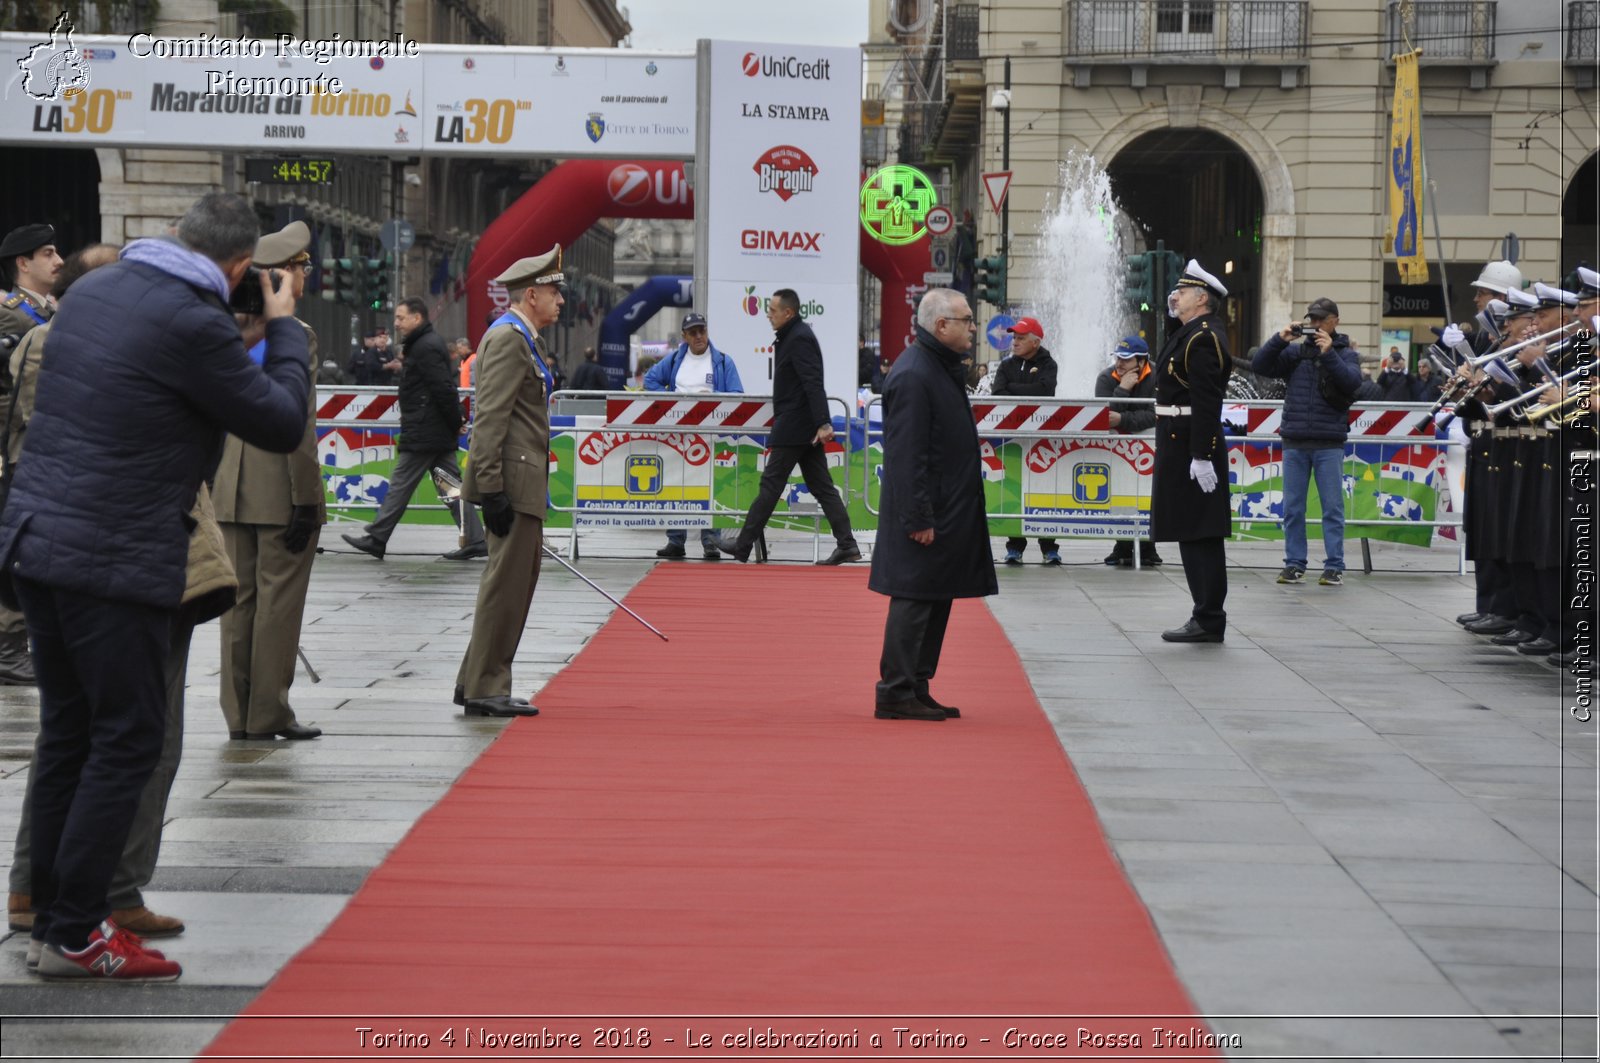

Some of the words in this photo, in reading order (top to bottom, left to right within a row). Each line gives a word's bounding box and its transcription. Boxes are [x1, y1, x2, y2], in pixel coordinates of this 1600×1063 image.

[762, 55, 830, 80] UniCredit
[150, 83, 270, 114] Maratona
[309, 84, 392, 117] Torino
[601, 96, 615, 104] con
[615, 95, 621, 103] il
[621, 95, 660, 104] patrocinio
[660, 96, 668, 104] di
[742, 103, 762, 118] LA
[768, 104, 830, 121] STAMPA
[264, 125, 306, 139] ARRIVO
[759, 162, 813, 195] Biraghi
[741, 229, 821, 252] GIMAX
[1393, 295, 1430, 311] Store
[576, 517, 593, 526] Per
[595, 518, 610, 526] noi
[612, 518, 621, 526] la
[624, 517, 656, 528] qualità
[659, 517, 665, 526] è
[667, 518, 710, 527] centrale.
[1024, 525, 1041, 533] Per
[1044, 526, 1058, 534] noi
[1061, 526, 1070, 534] la
[1073, 526, 1105, 536] qualità
[1108, 527, 1114, 535] è
